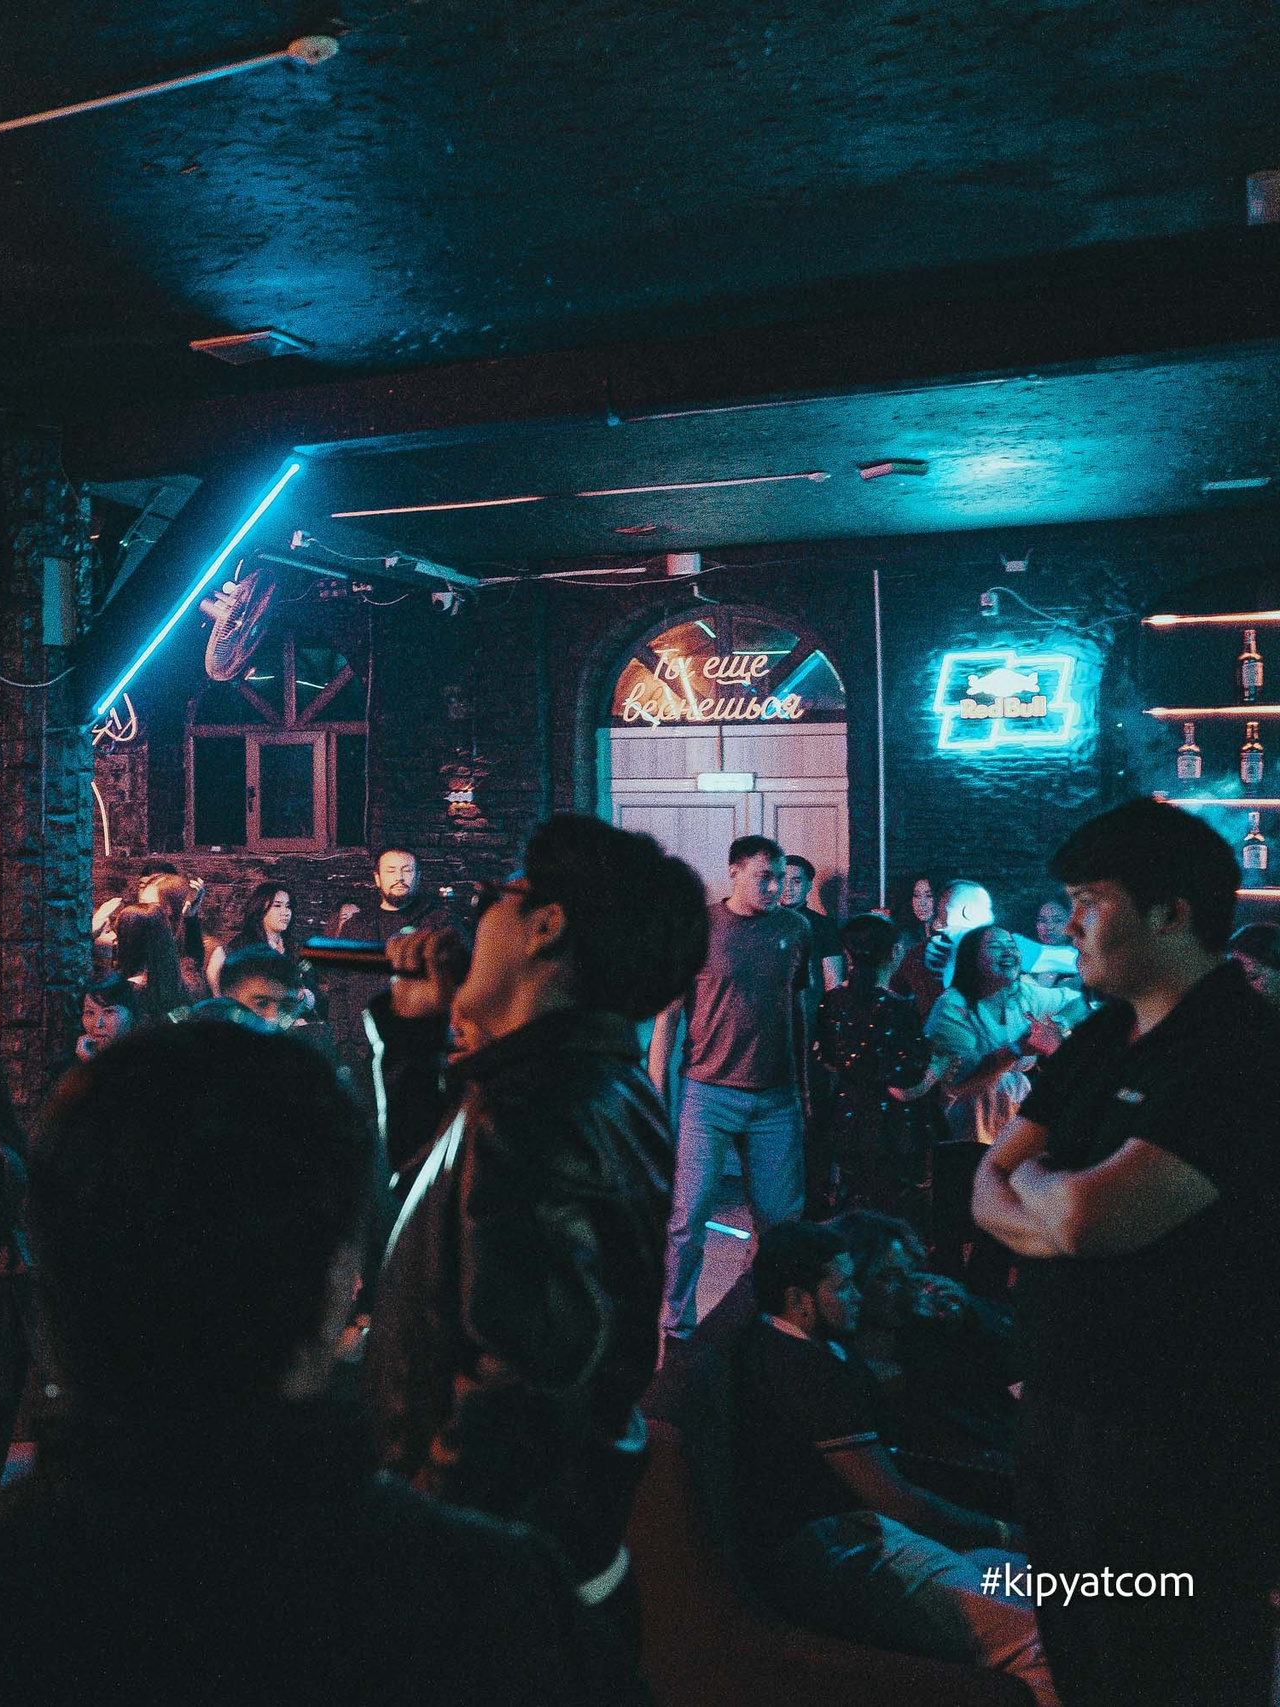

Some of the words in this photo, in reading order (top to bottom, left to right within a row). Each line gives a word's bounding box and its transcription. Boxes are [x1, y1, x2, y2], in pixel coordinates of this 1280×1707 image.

[702, 654, 770, 685] еще
[960, 698, 1004, 719] Red
[1004, 695, 1047, 718] Bull
